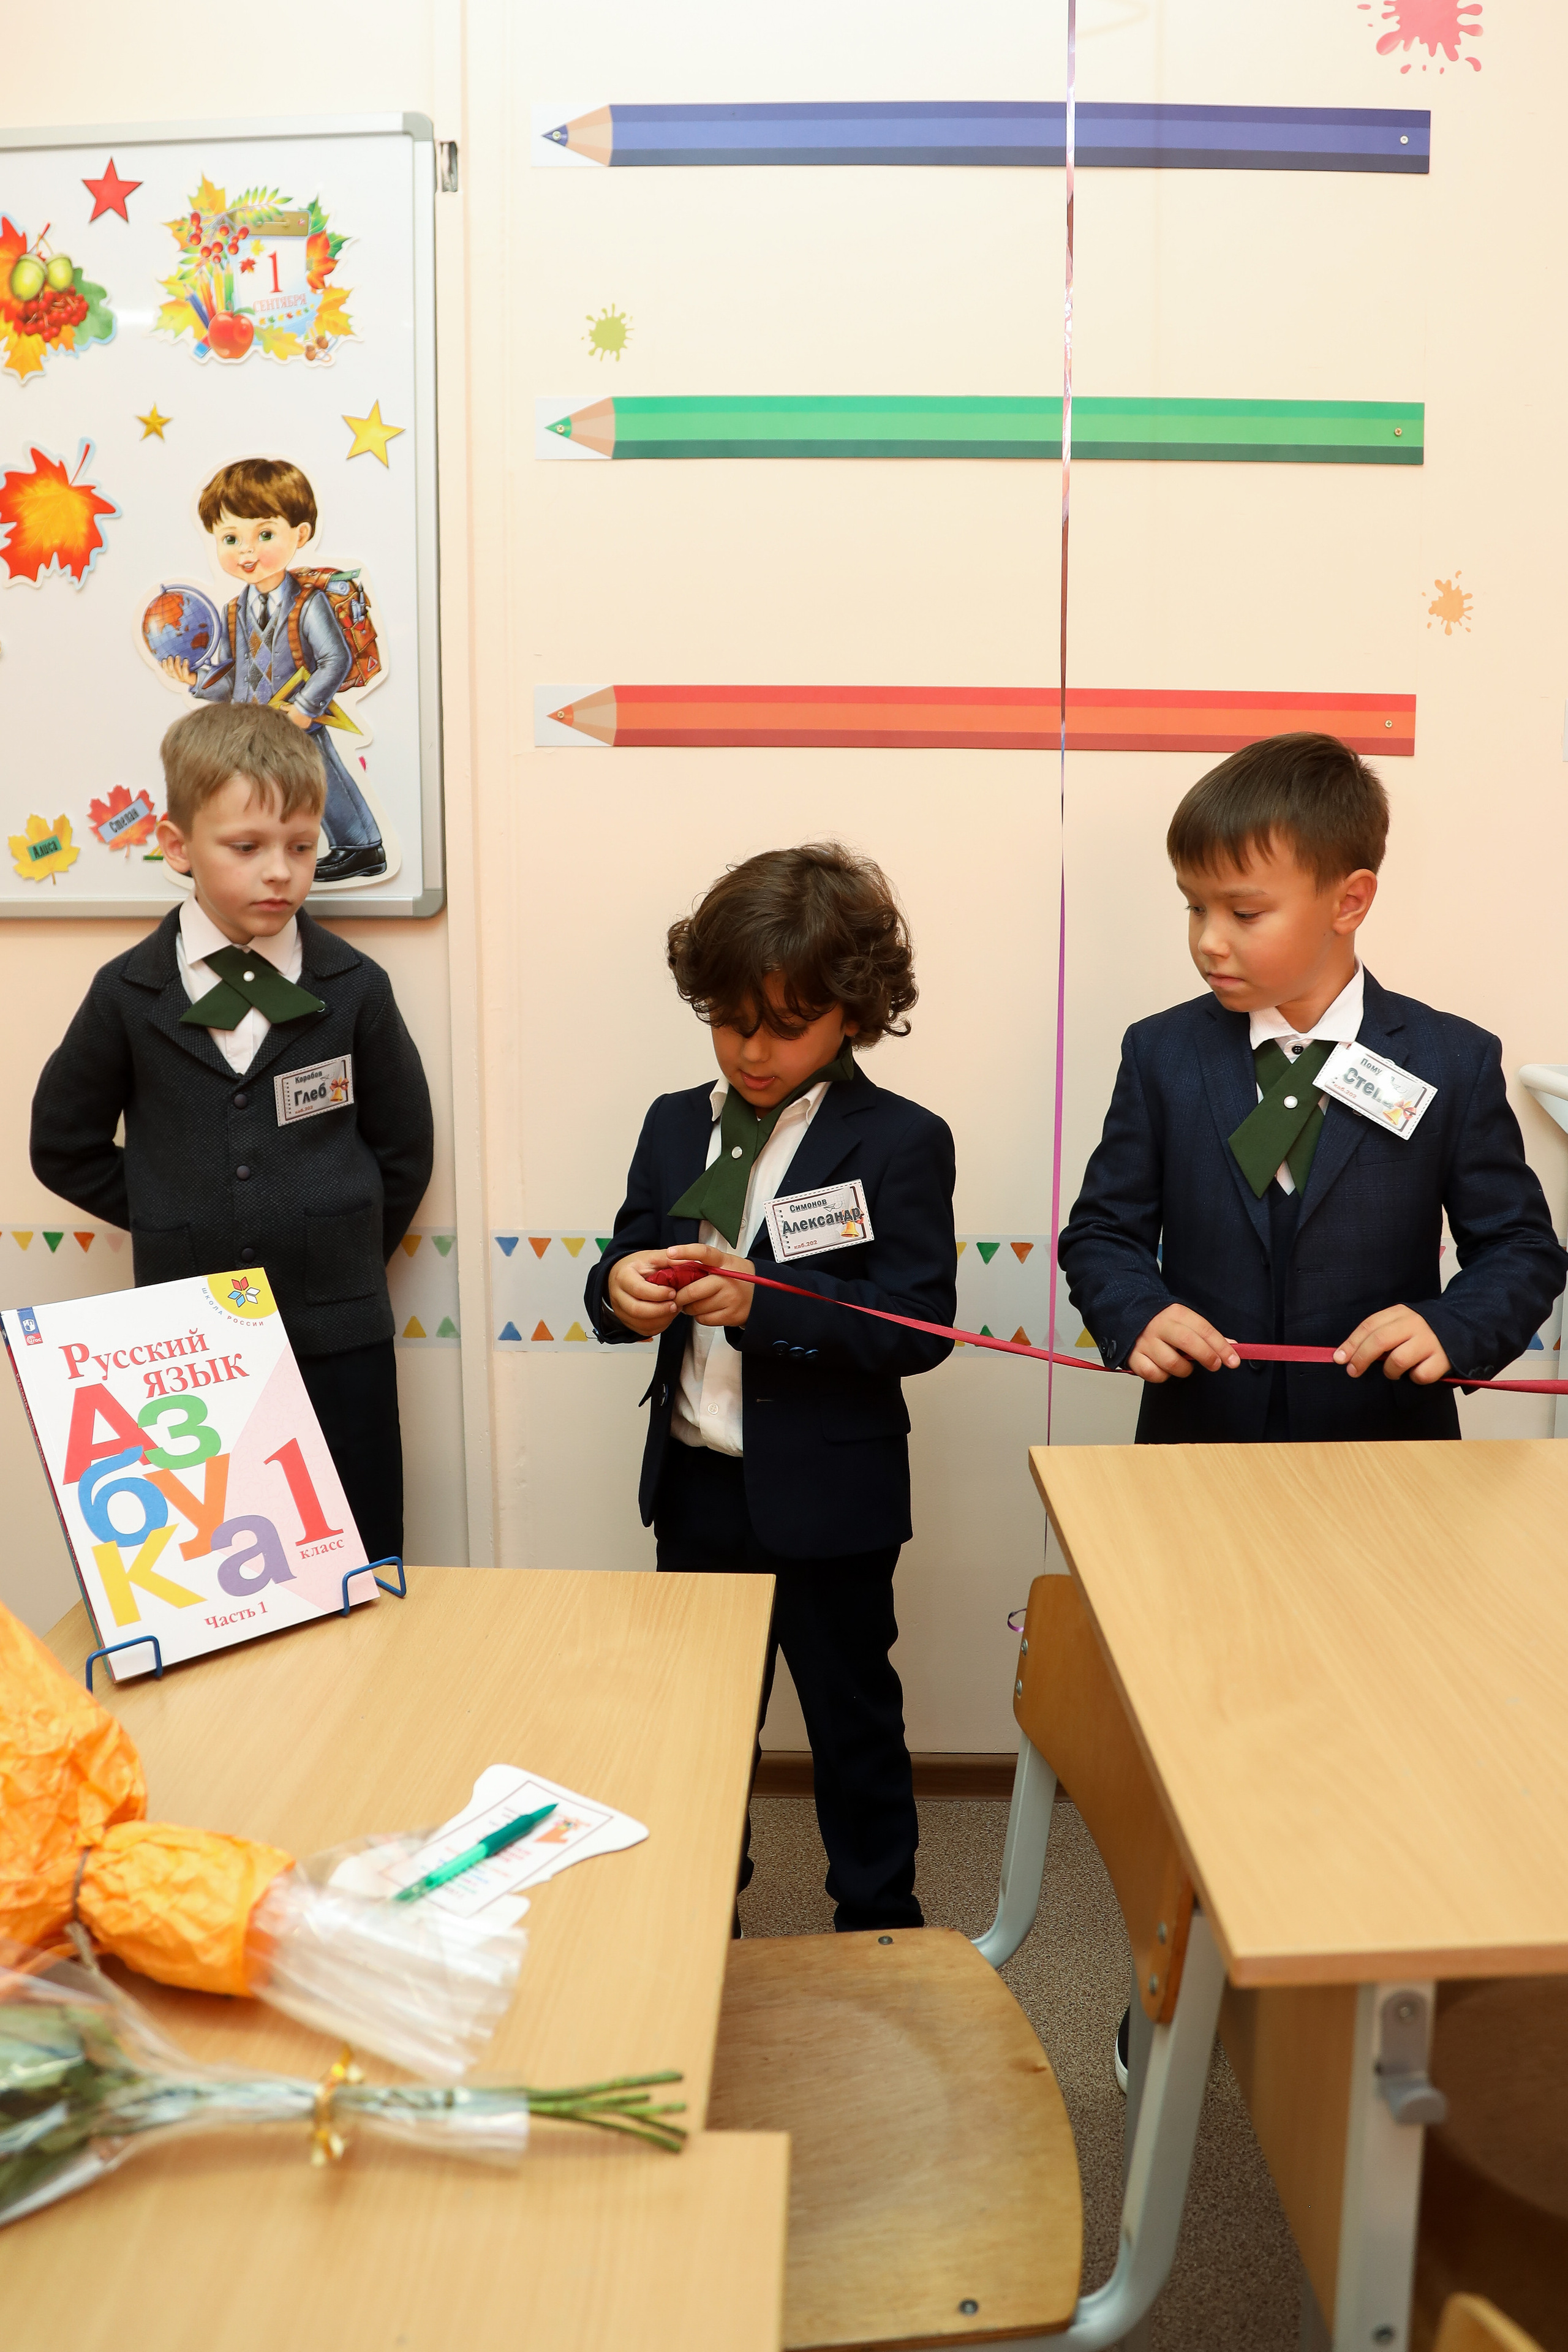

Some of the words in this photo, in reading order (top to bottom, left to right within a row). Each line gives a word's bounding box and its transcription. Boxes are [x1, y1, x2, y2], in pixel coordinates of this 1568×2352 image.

[268, 249, 283, 293] 1
[252, 293, 307, 313] СЕНТЯБРЯ
[109, 808, 140, 833] Степан
[32, 840, 58, 859] Алиса
[295, 1071, 323, 1084] Коробов
[294, 1082, 326, 1106] Глеб
[1333, 1084, 1357, 1099] каб.202
[790, 1199, 827, 1213] Симонов
[782, 1207, 861, 1235] Александр
[794, 1240, 818, 1250] каб.202
[202, 1287, 223, 1315] ШКОЛА
[227, 1315, 265, 1327] РОССИИ
[58, 1327, 210, 1381] Русский
[143, 1353, 250, 1398] язык
[263, 1437, 344, 1547] 1
[299, 1539, 345, 1560] класс
[204, 1608, 256, 1629] Часть
[257, 1600, 268, 1615] 1
